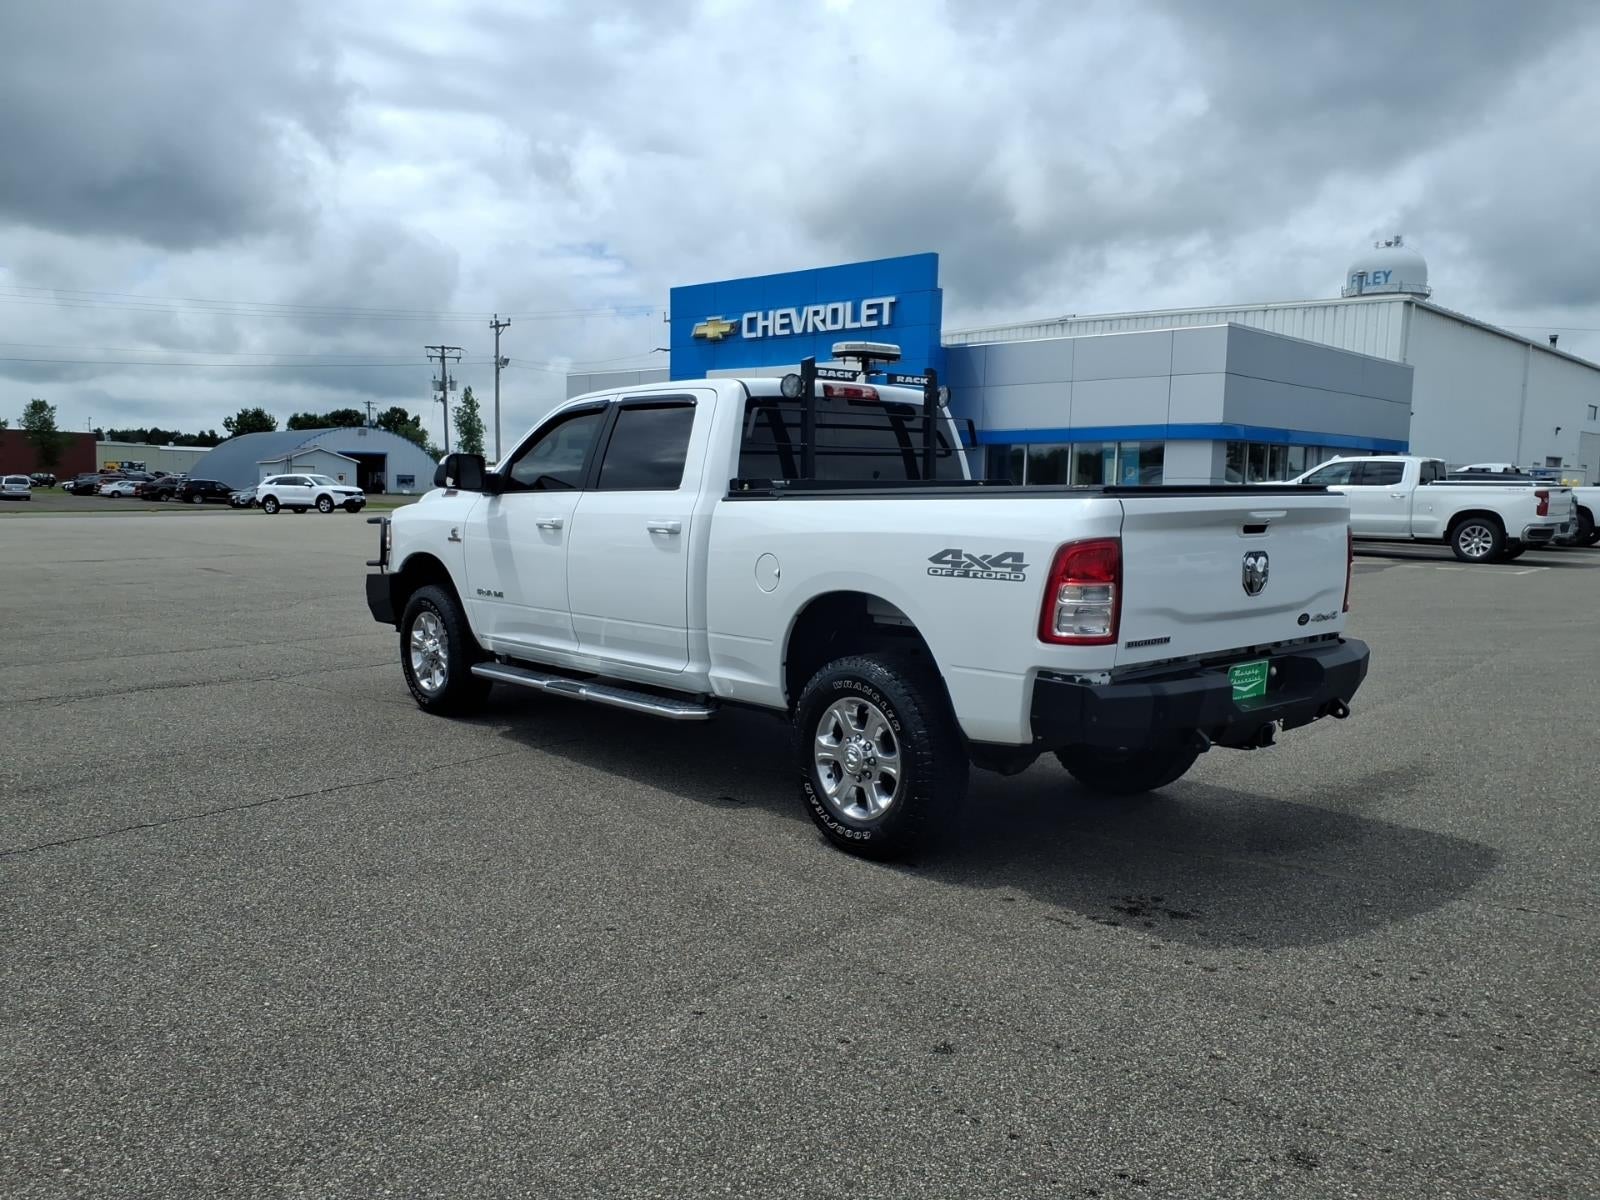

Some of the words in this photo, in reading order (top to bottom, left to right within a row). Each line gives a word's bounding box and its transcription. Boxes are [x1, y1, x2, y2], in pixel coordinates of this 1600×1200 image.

[1351, 270, 1392, 288] FLEY
[741, 296, 897, 339] CHEVROLET
[817, 369, 853, 378] BACK
[896, 375, 929, 385] RACK
[928, 568, 965, 577] OFF
[968, 570, 1025, 580] ROAD
[832, 679, 901, 732] WRANGLER
[804, 782, 872, 840] GOODYEAR
